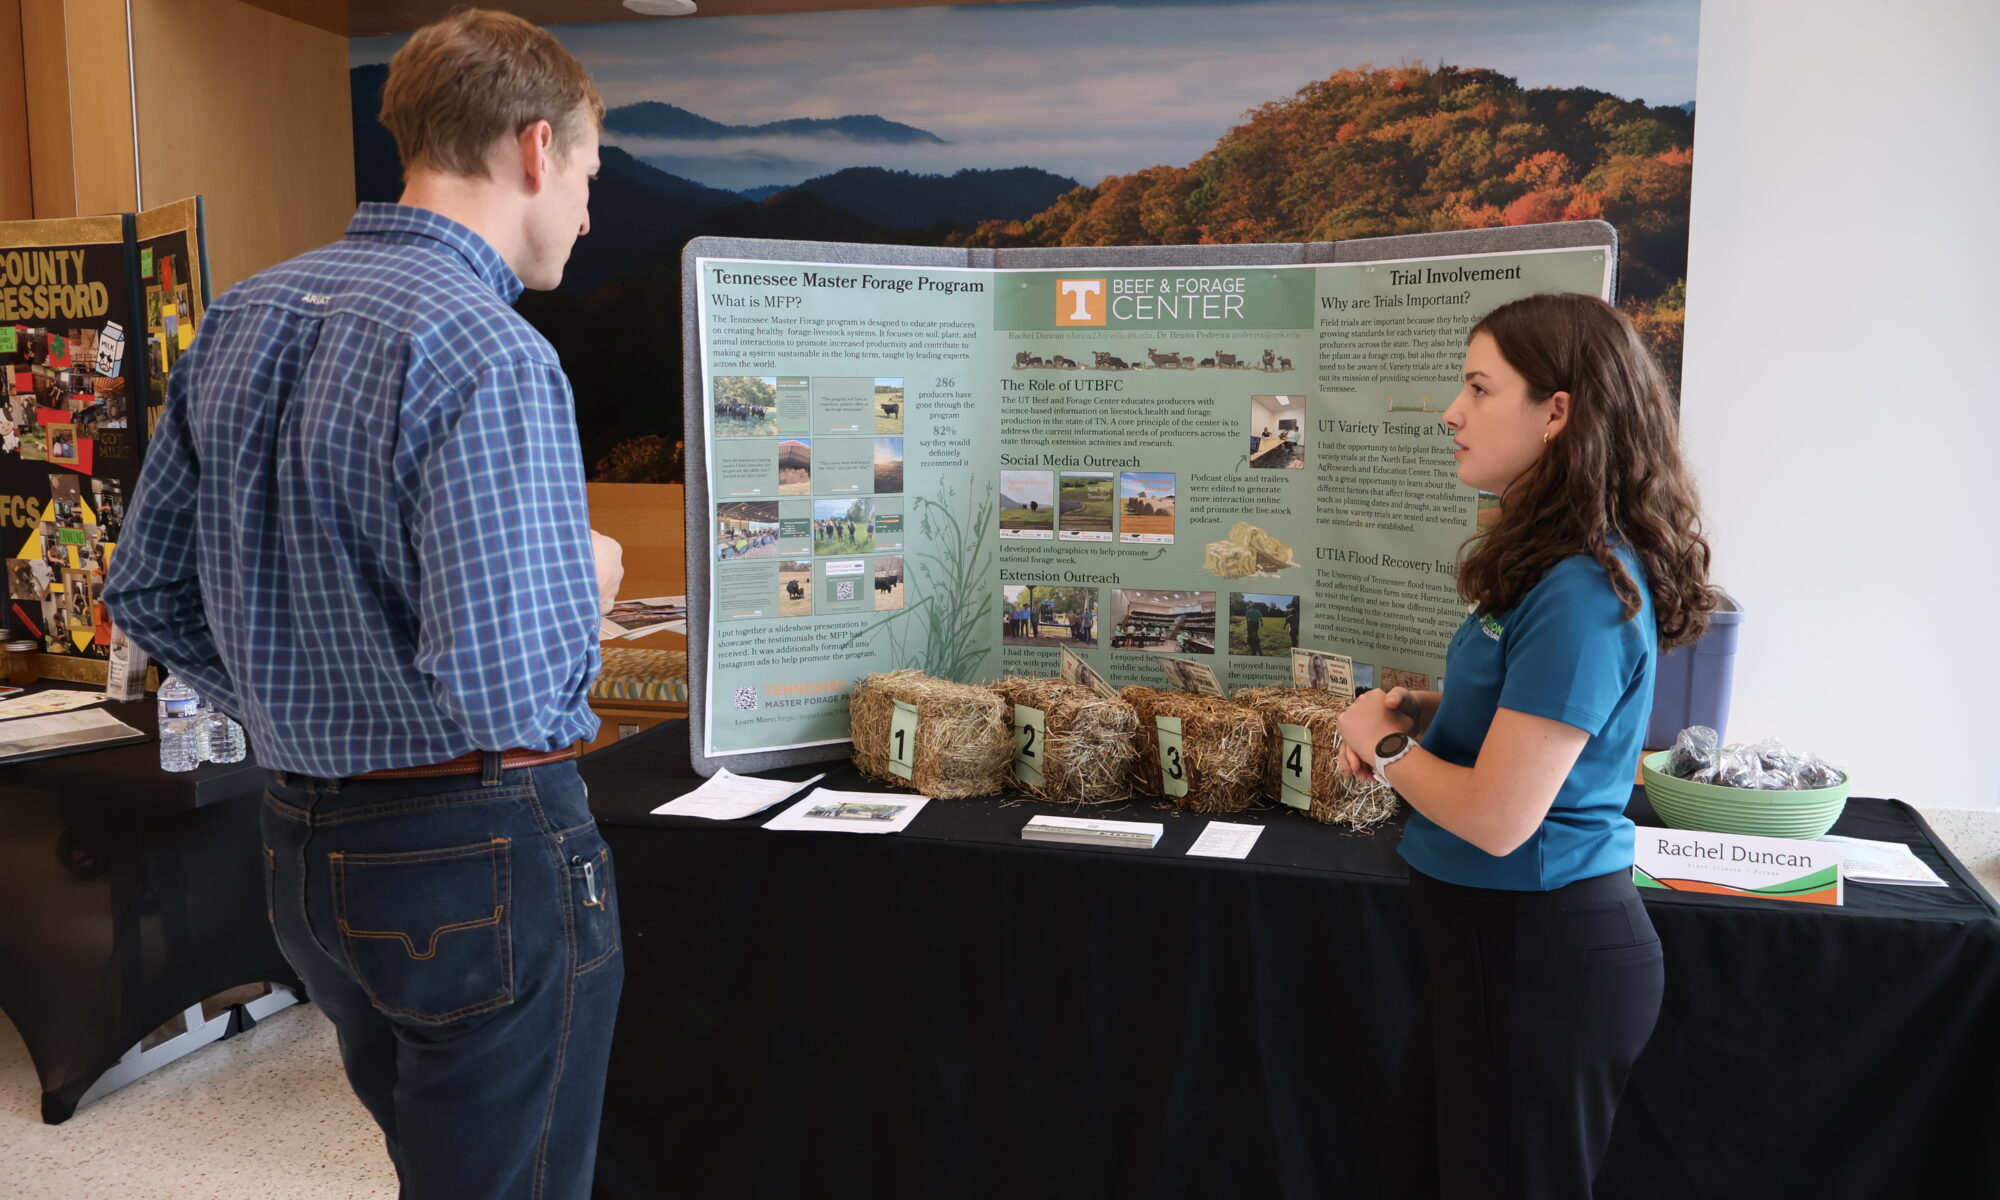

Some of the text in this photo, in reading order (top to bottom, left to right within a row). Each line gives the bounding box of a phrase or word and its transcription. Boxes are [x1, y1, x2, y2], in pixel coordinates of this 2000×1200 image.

[1390, 264, 1520, 286] Trial Involvement
[713, 269, 983, 296] Tennessee Master Forage Program
[1113, 277, 1246, 294] BEEF & FORAGE
[712, 294, 801, 308] What is MFP?
[1062, 281, 1100, 320] T
[1112, 294, 1244, 320] CENTER
[1321, 291, 1470, 312] Why are Trials Important?
[713, 315, 974, 330] The Tennessee Master Forage program is designed to educate producers
[1008, 332, 1033, 340] Rachel
[1169, 331, 1194, 339] Bruno
[1196, 331, 1229, 339] Pedreira
[101, 341, 115, 352] MILK
[738, 360, 751, 368] the
[935, 378, 954, 388] 286
[1000, 379, 1122, 392] The Role of UTBFC
[918, 391, 971, 400] producers have
[1002, 396, 1016, 404] The
[1018, 396, 1028, 404] UT
[1066, 397, 1091, 406] Forage
[1093, 397, 1119, 405] Center
[1120, 397, 1154, 405] educates
[1156, 397, 1195, 407] producers
[934, 401, 961, 410] through
[963, 401, 974, 409] the
[929, 413, 959, 421] program
[933, 426, 956, 436] 82%
[1318, 421, 1336, 433] UT
[1338, 421, 1378, 437] Variety
[1382, 423, 1420, 438] Testing
[1423, 424, 1432, 436] at
[932, 439, 946, 448] they
[928, 449, 960, 458] definitely
[1000, 453, 1139, 467] Social Media Outreach
[920, 459, 968, 467] recommend it
[1191, 474, 1288, 484] Podcast clips and trailers
[1317, 474, 1333, 482] such
[1339, 476, 1356, 485] great
[1357, 477, 1397, 488] opportunity
[1406, 479, 1423, 487] learn
[1424, 480, 1443, 489] about
[1211, 484, 1235, 492] edited
[1237, 485, 1245, 493] to
[1247, 485, 1280, 495] generate
[1316, 485, 1474, 502] different factors that affect forage establishment
[1212, 495, 1254, 503] interaction
[1256, 496, 1280, 504] online
[0, 495, 40, 529] FCS
[1190, 505, 1204, 513] and
[1206, 505, 1239, 515] promote
[1241, 506, 1253, 514] the
[1189, 516, 1221, 526] podcast.
[1316, 548, 1345, 563] UTIA
[1348, 551, 1378, 566] Flood
[1382, 555, 1431, 575] Recovery
[1000, 569, 1119, 583] Extension Outreach
[1315, 580, 1454, 604] flood affected Runion farm since Hurricane
[718, 629, 720, 638] I
[722, 628, 733, 639] put
[735, 626, 766, 638] together
[775, 623, 812, 634] slideshow
[814, 619, 858, 633] presentation
[860, 619, 867, 627] to
[718, 651, 876, 671] Instagram ads to help promote the program.
[1228, 661, 1292, 674] I enjoyed having
[764, 680, 847, 696] TENNESSEE
[765, 697, 801, 709] MASTER
[804, 694, 841, 705] FORAGE
[734, 717, 754, 726] Learn
[755, 715, 778, 724] More:
[895, 729, 905, 760] 1
[1022, 724, 1036, 758] 2
[1167, 746, 1183, 780] 3
[1286, 743, 1303, 778] 4
[1658, 840, 1811, 869] Rachel Duncan
